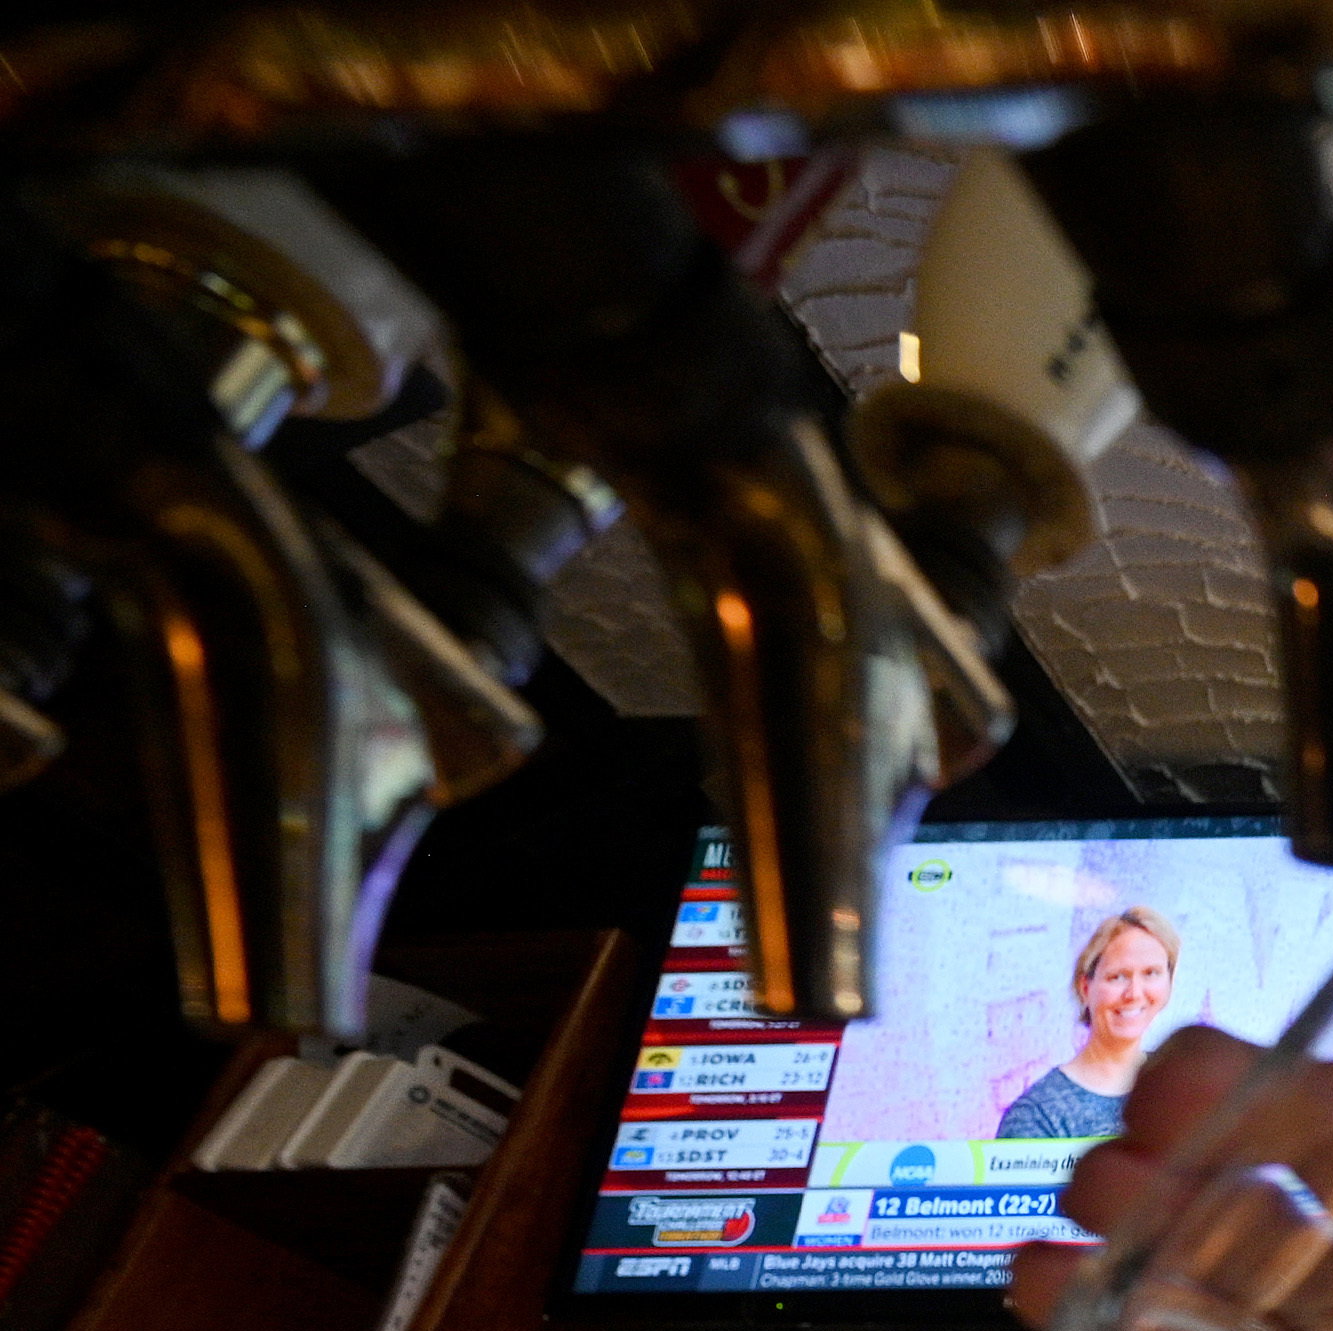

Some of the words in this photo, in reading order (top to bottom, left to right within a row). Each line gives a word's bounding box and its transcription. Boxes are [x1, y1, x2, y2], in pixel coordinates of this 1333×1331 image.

[701, 1053, 756, 1065] IOWA
[695, 1073, 746, 1086] RICH
[681, 1128, 739, 1141] PROV
[676, 1150, 727, 1163] SDST
[875, 1198, 898, 1216] 12
[905, 1195, 994, 1216] Belmont
[999, 1193, 1056, 1216] (22-7)
[1008, 1223, 1065, 1241] straight
[615, 1256, 692, 1277] ESPN
[708, 1257, 741, 1271] MLB
[763, 1254, 800, 1270] Blue
[802, 1254, 836, 1271] Jays
[837, 1254, 893, 1271] acquire
[920, 1252, 954, 1268] Matt
